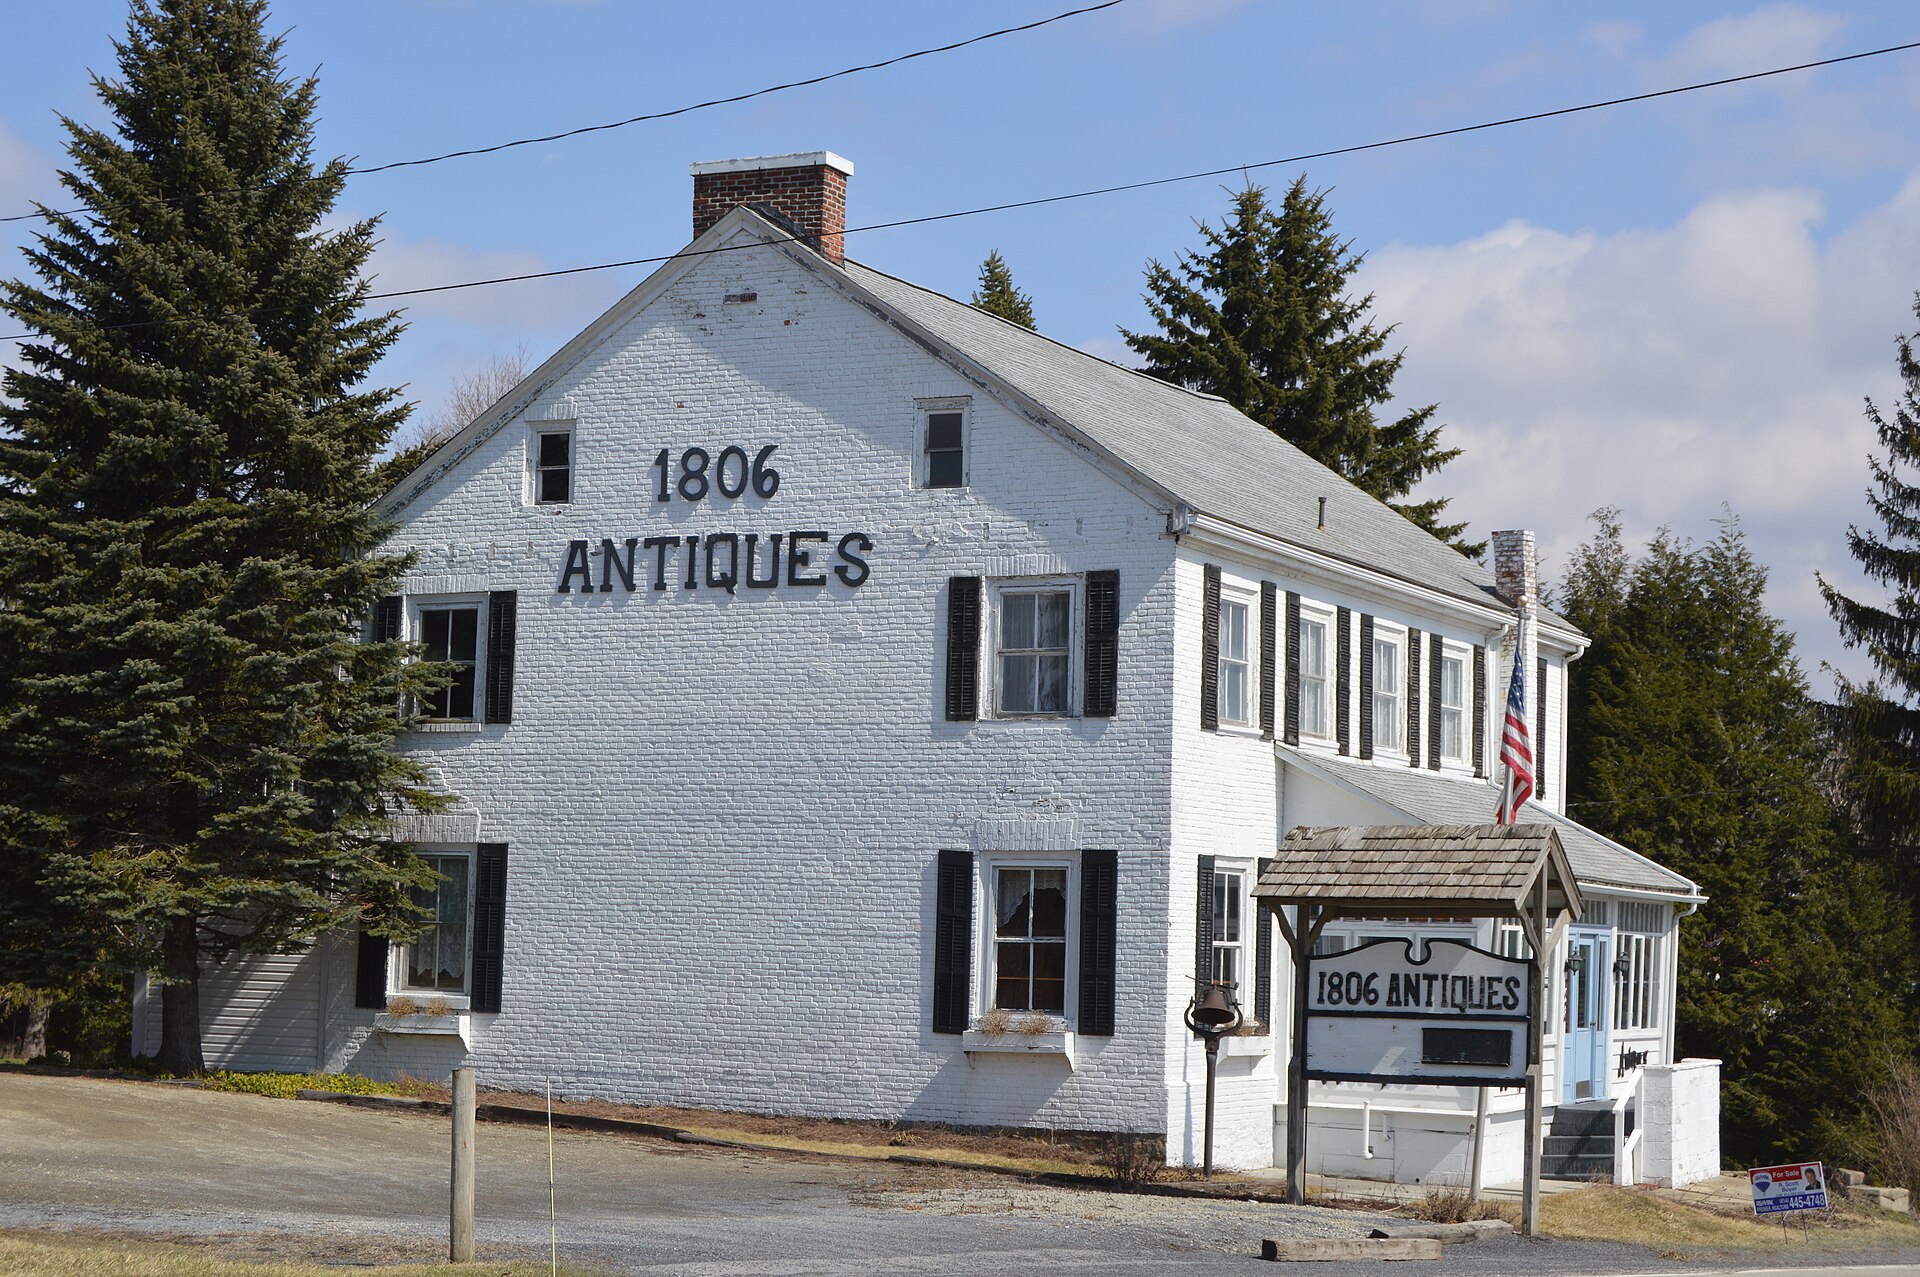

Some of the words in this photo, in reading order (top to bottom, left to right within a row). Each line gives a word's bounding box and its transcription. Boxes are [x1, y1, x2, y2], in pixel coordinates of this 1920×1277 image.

[655, 445, 780, 502] 1806
[558, 531, 873, 595] ANTIQUES
[1317, 972, 1379, 1006] 1806
[1386, 973, 1521, 1013] ANTIQUES
[1789, 1194, 1825, 1208] 445-4748
